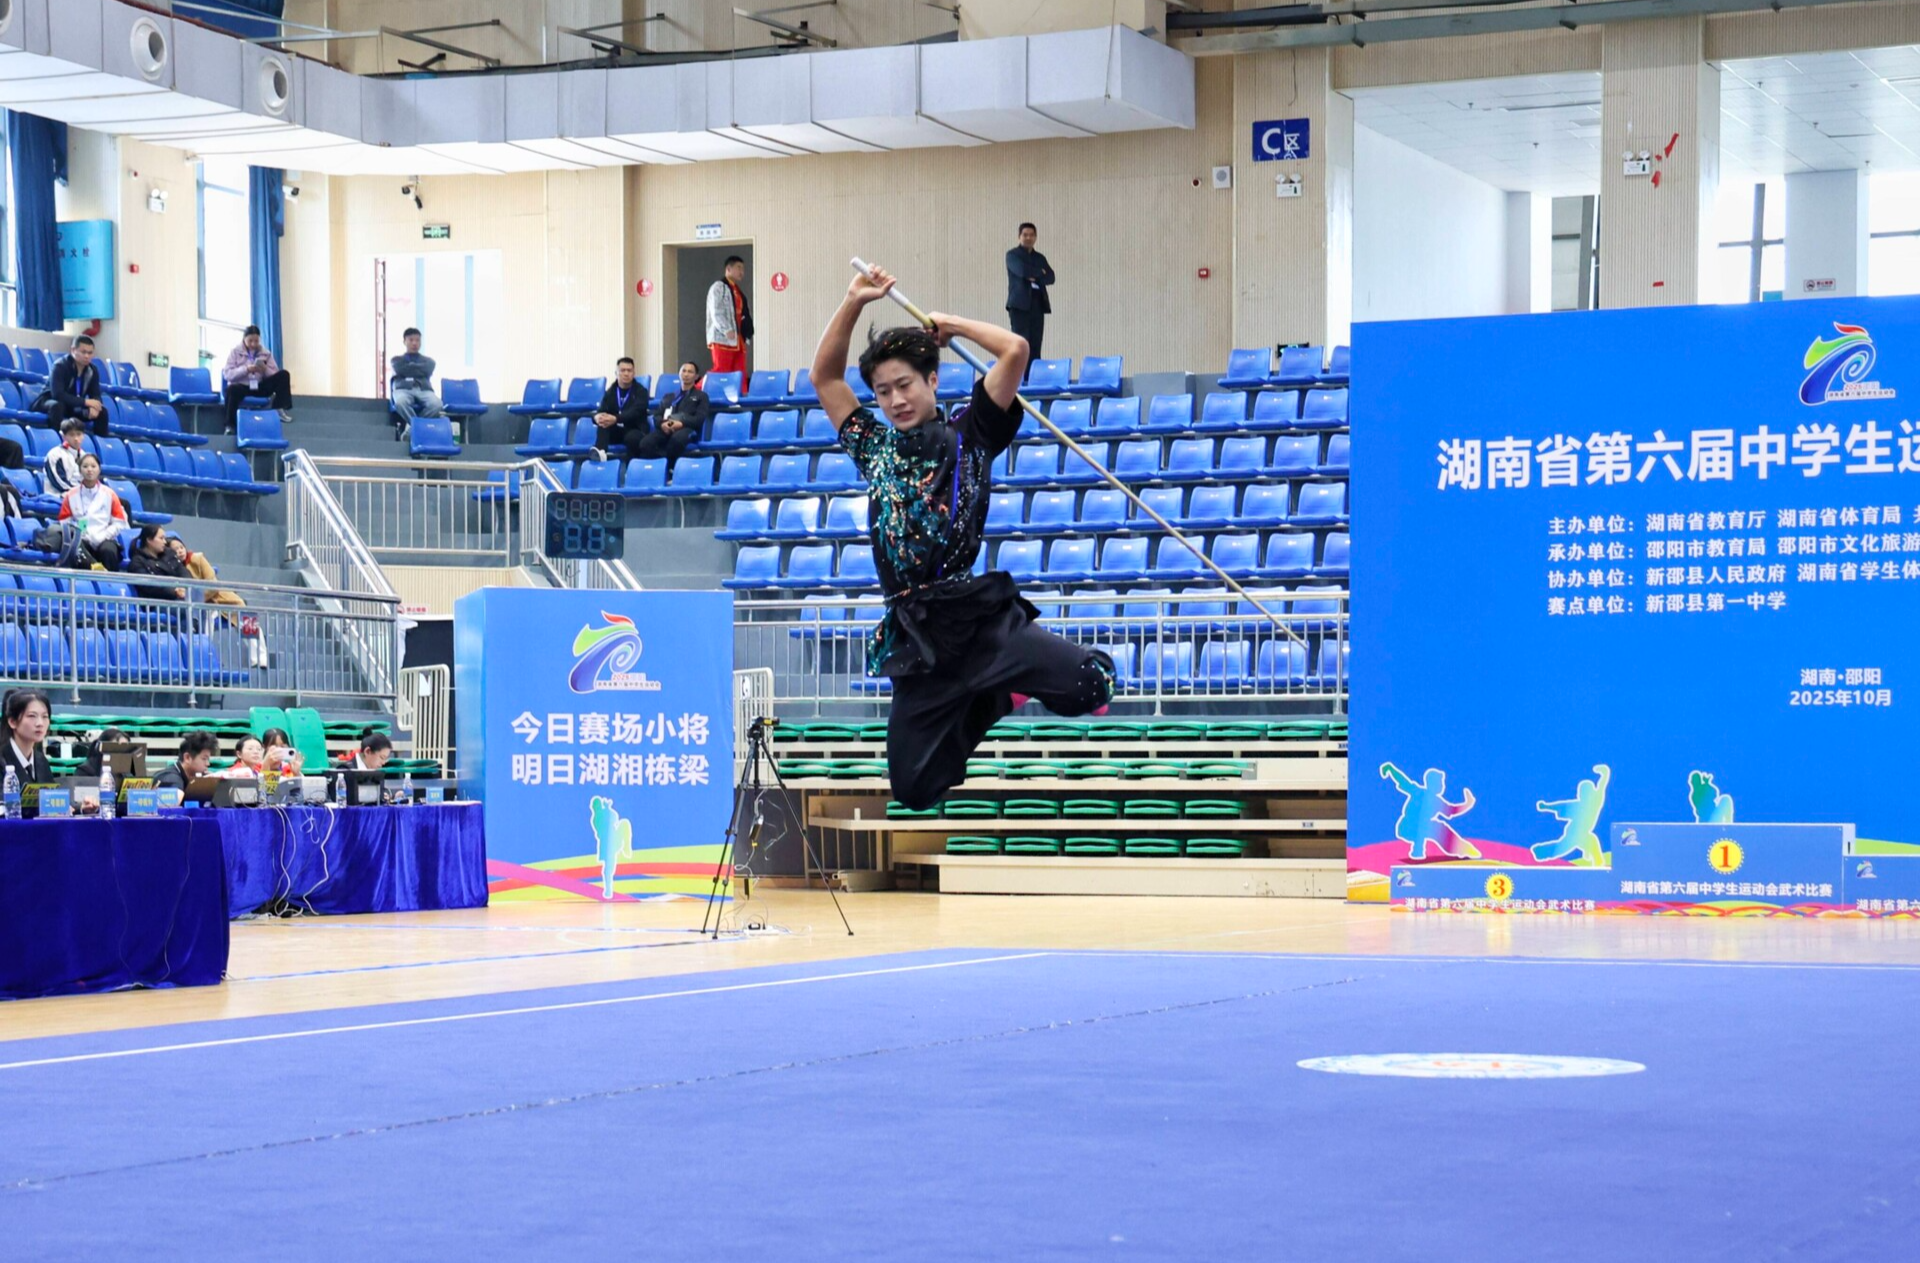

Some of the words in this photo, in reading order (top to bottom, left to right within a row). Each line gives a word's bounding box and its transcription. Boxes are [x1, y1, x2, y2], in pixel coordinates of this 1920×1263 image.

[1646, 510, 1767, 533] 湖南省教育厅
[1777, 505, 1901, 528] 湖南省体育局
[1646, 538, 1766, 559] 邵阳市教育局
[1777, 532, 1920, 555] 邵阳市文化旅游
[1646, 564, 1786, 586] 新邵县人民政府
[1797, 560, 1920, 582] 湖南省学生体
[1646, 591, 1786, 613] 新邵县第一中学
[1789, 689, 1892, 707] 2025年10月
[511, 711, 710, 745] 今日赛场小将
[511, 753, 710, 786] 明日湖湘栋梁
[1718, 845, 1733, 868] 1
[1493, 878, 1505, 896] 3
[1620, 880, 1833, 898] 湖南省第六届中学生运动会武术比赛
